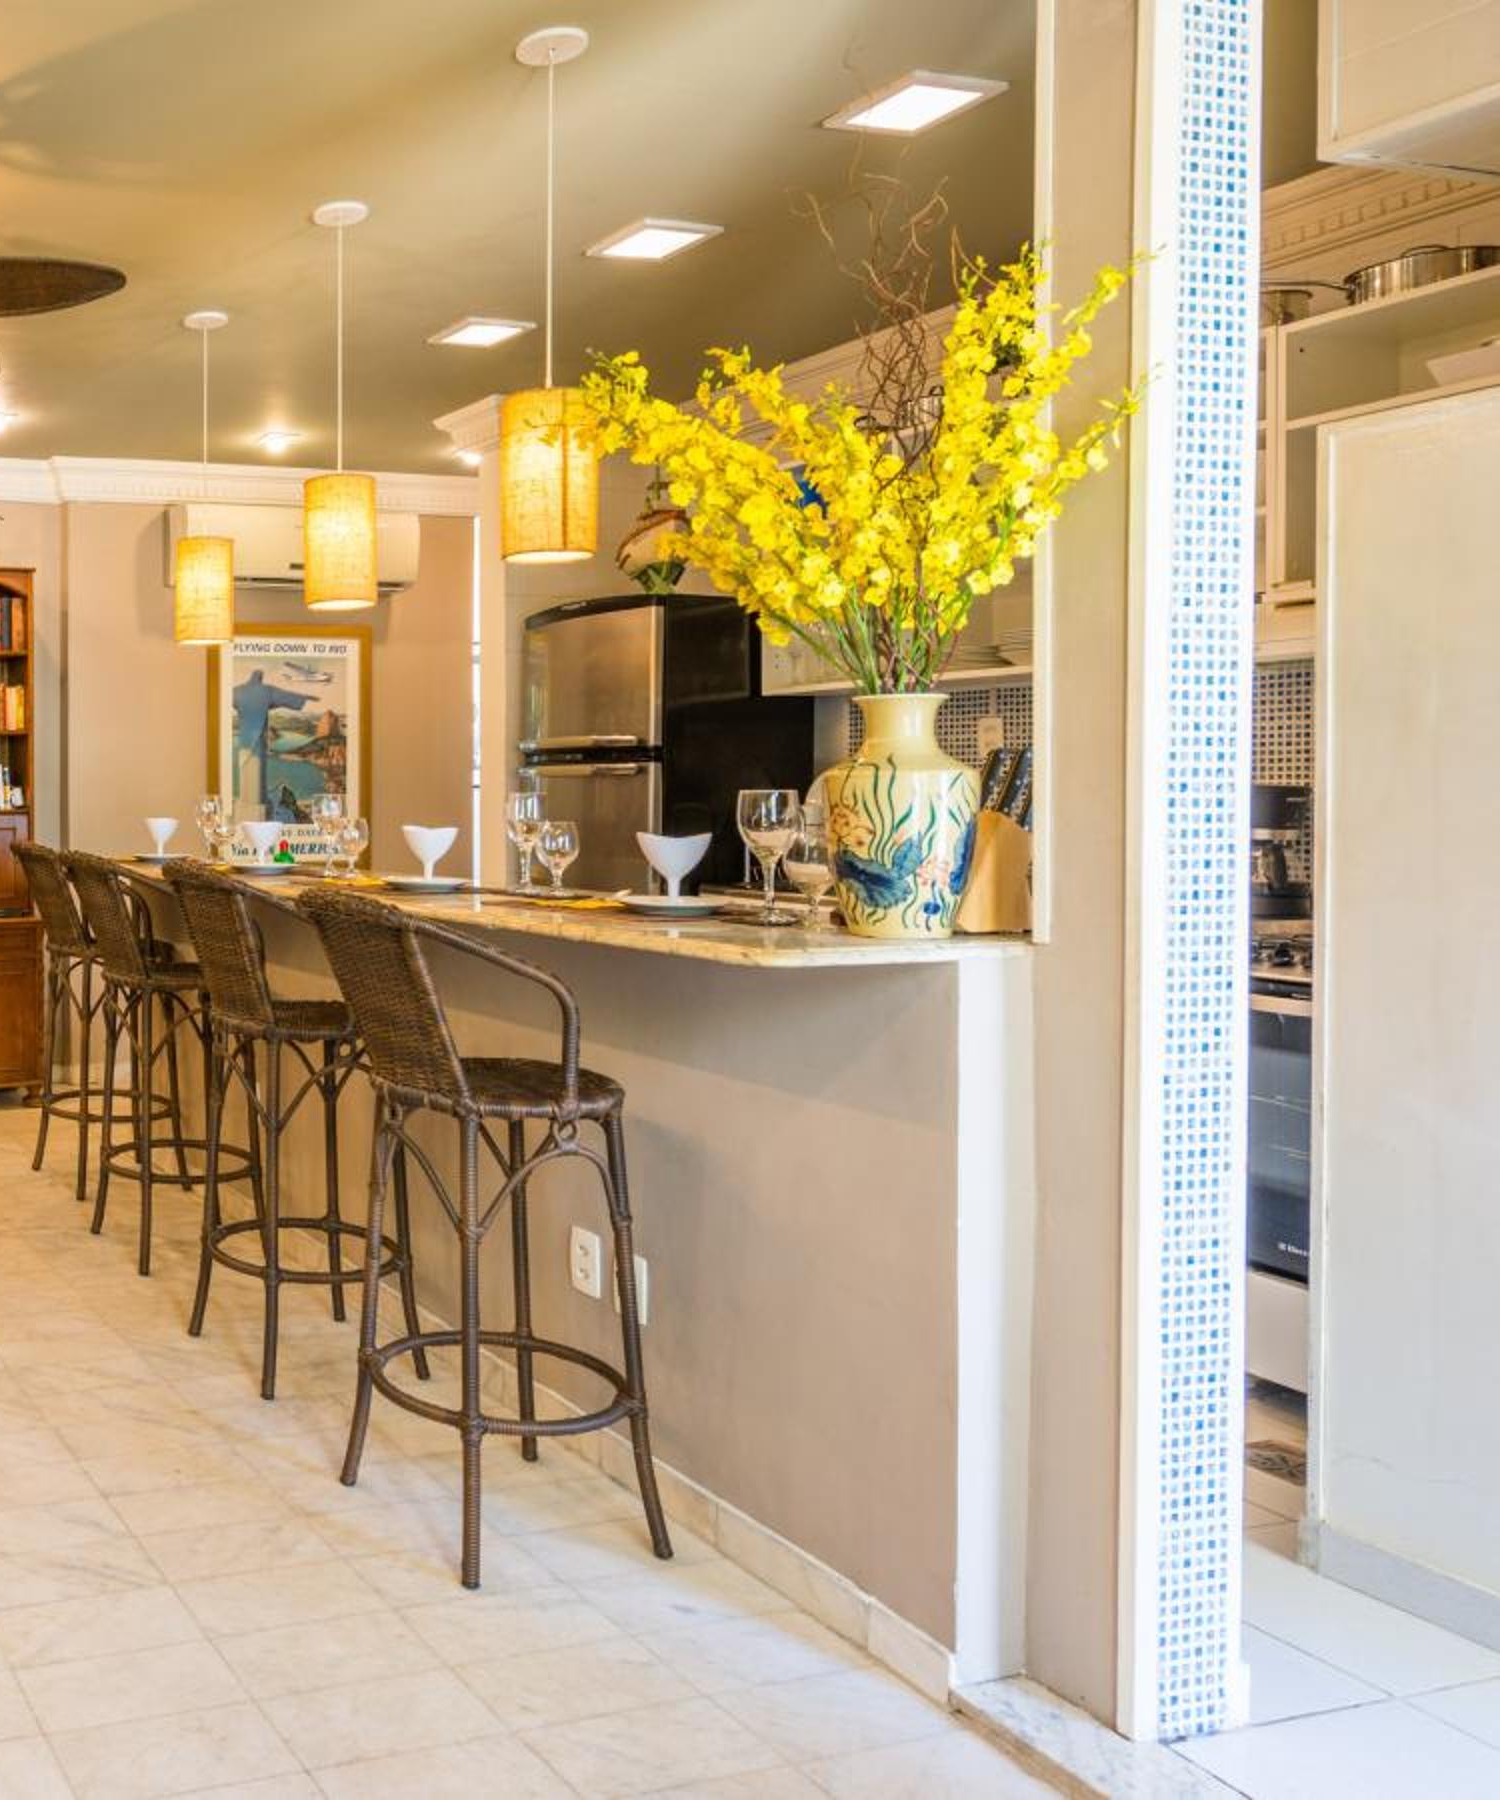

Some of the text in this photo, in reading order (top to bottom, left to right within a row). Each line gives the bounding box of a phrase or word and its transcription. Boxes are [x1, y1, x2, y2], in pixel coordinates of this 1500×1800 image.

[233, 643, 271, 653] FLYING
[273, 643, 308, 653] DOWN
[312, 643, 326, 653] TO
